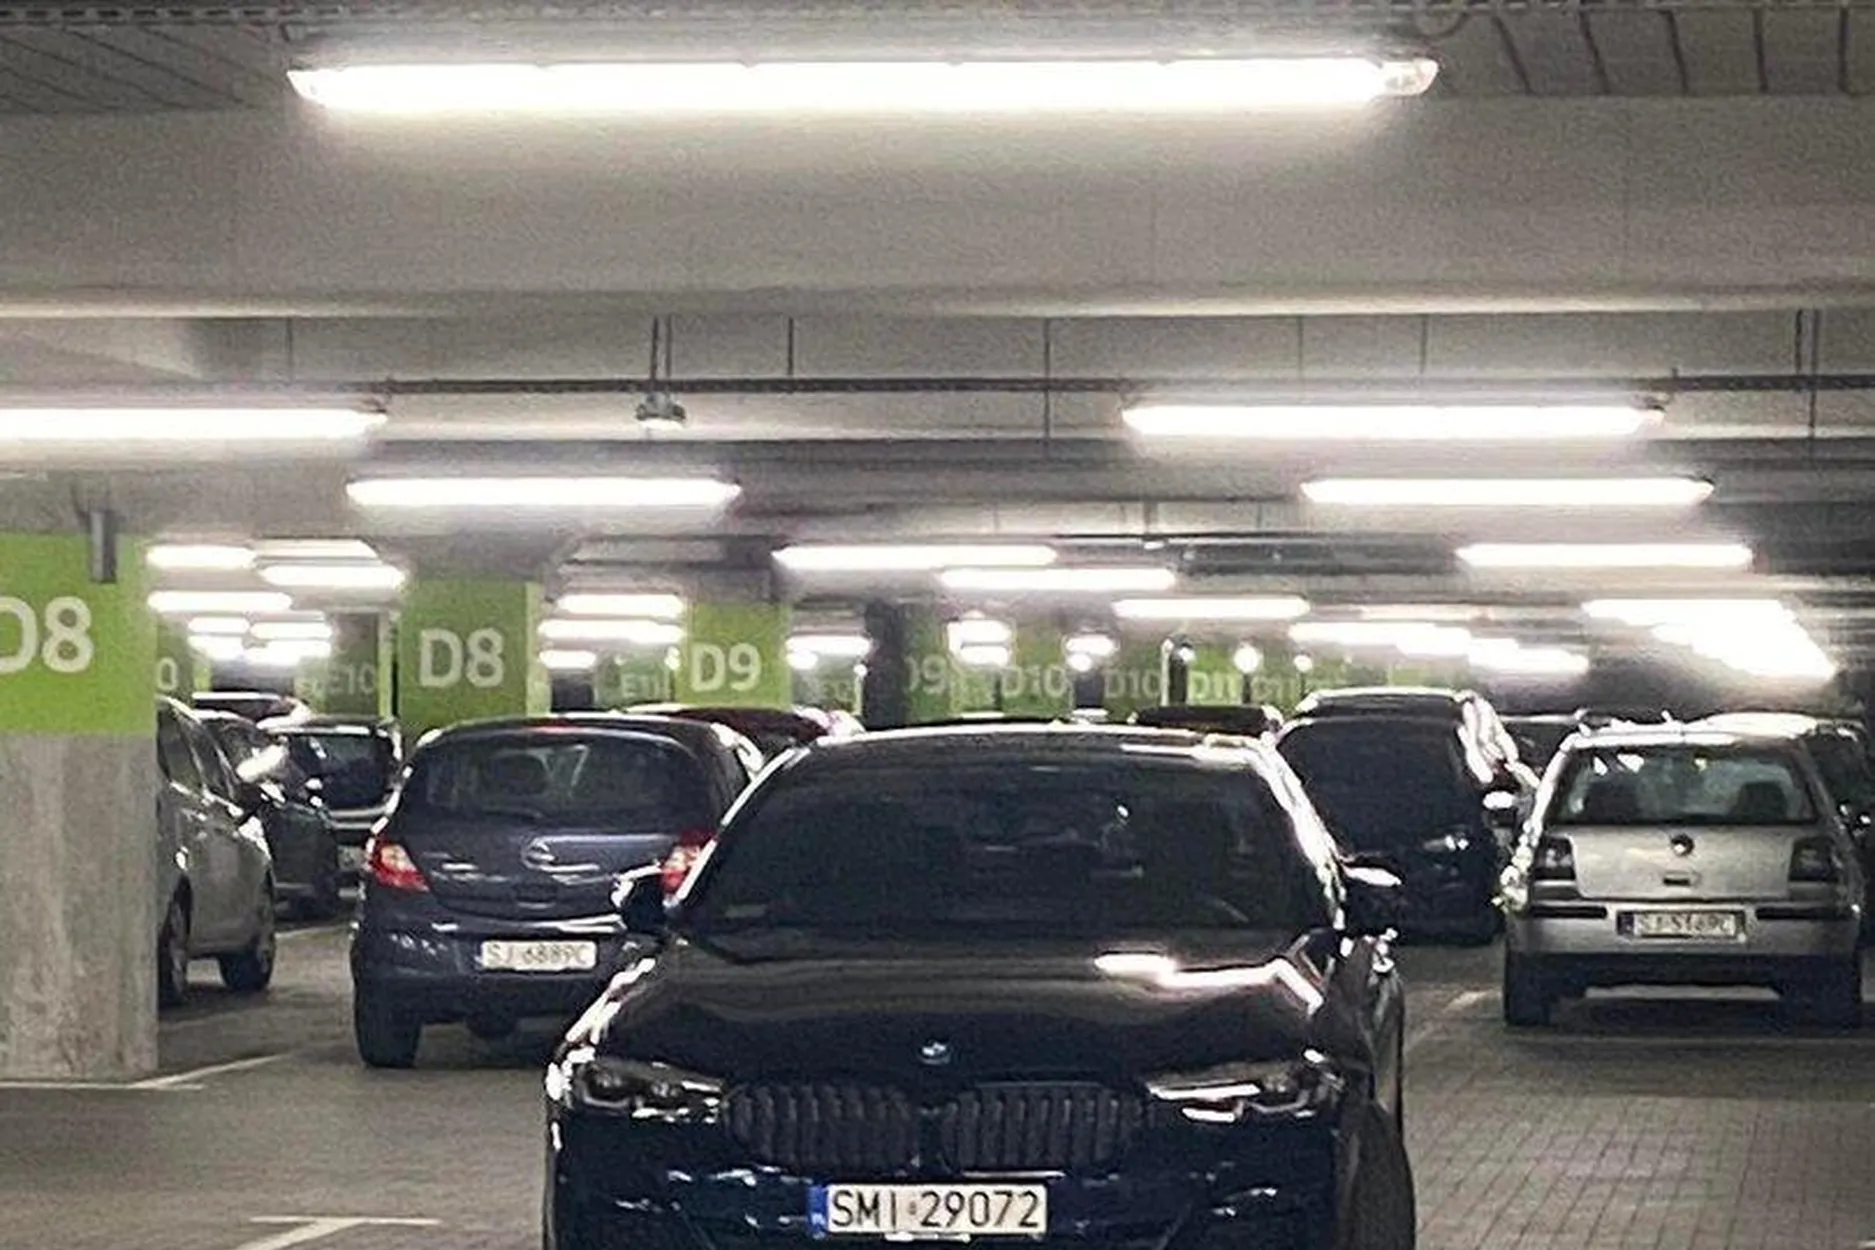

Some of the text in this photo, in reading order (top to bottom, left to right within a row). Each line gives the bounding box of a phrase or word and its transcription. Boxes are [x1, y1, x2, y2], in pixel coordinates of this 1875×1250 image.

[420, 628, 504, 688] D8
[691, 643, 762, 692] D9
[1002, 666, 1067, 697] D10
[1104, 671, 1160, 698] D10
[831, 1190, 1039, 1227] SMI 29072
